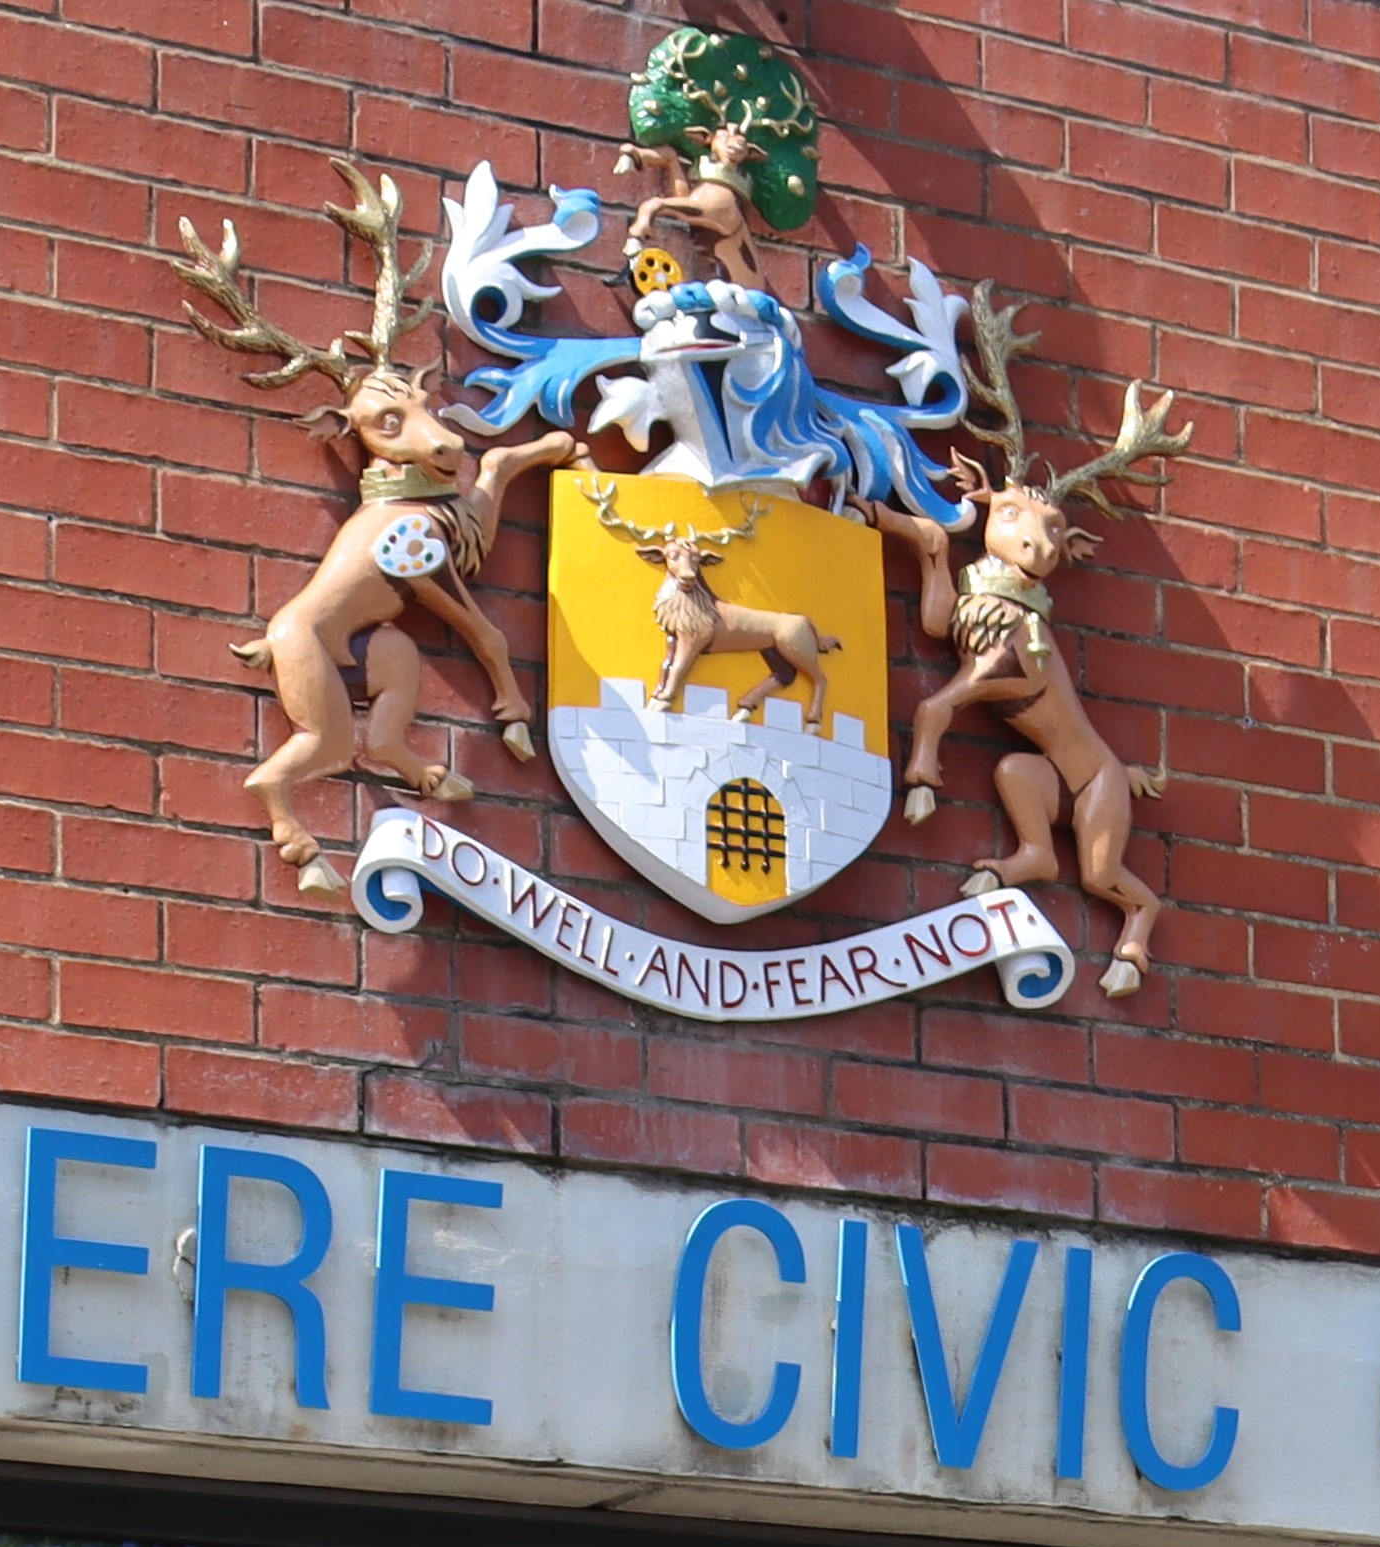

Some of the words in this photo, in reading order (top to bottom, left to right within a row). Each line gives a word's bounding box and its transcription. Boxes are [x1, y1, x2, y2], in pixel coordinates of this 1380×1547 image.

[416, 815, 487, 886] DO
[503, 863, 618, 977] WELL
[635, 945, 747, 1009] AND
[763, 946, 907, 1008] FEAR
[903, 899, 1019, 977] NOT
[670, 1197, 1242, 1492] CIVIC
